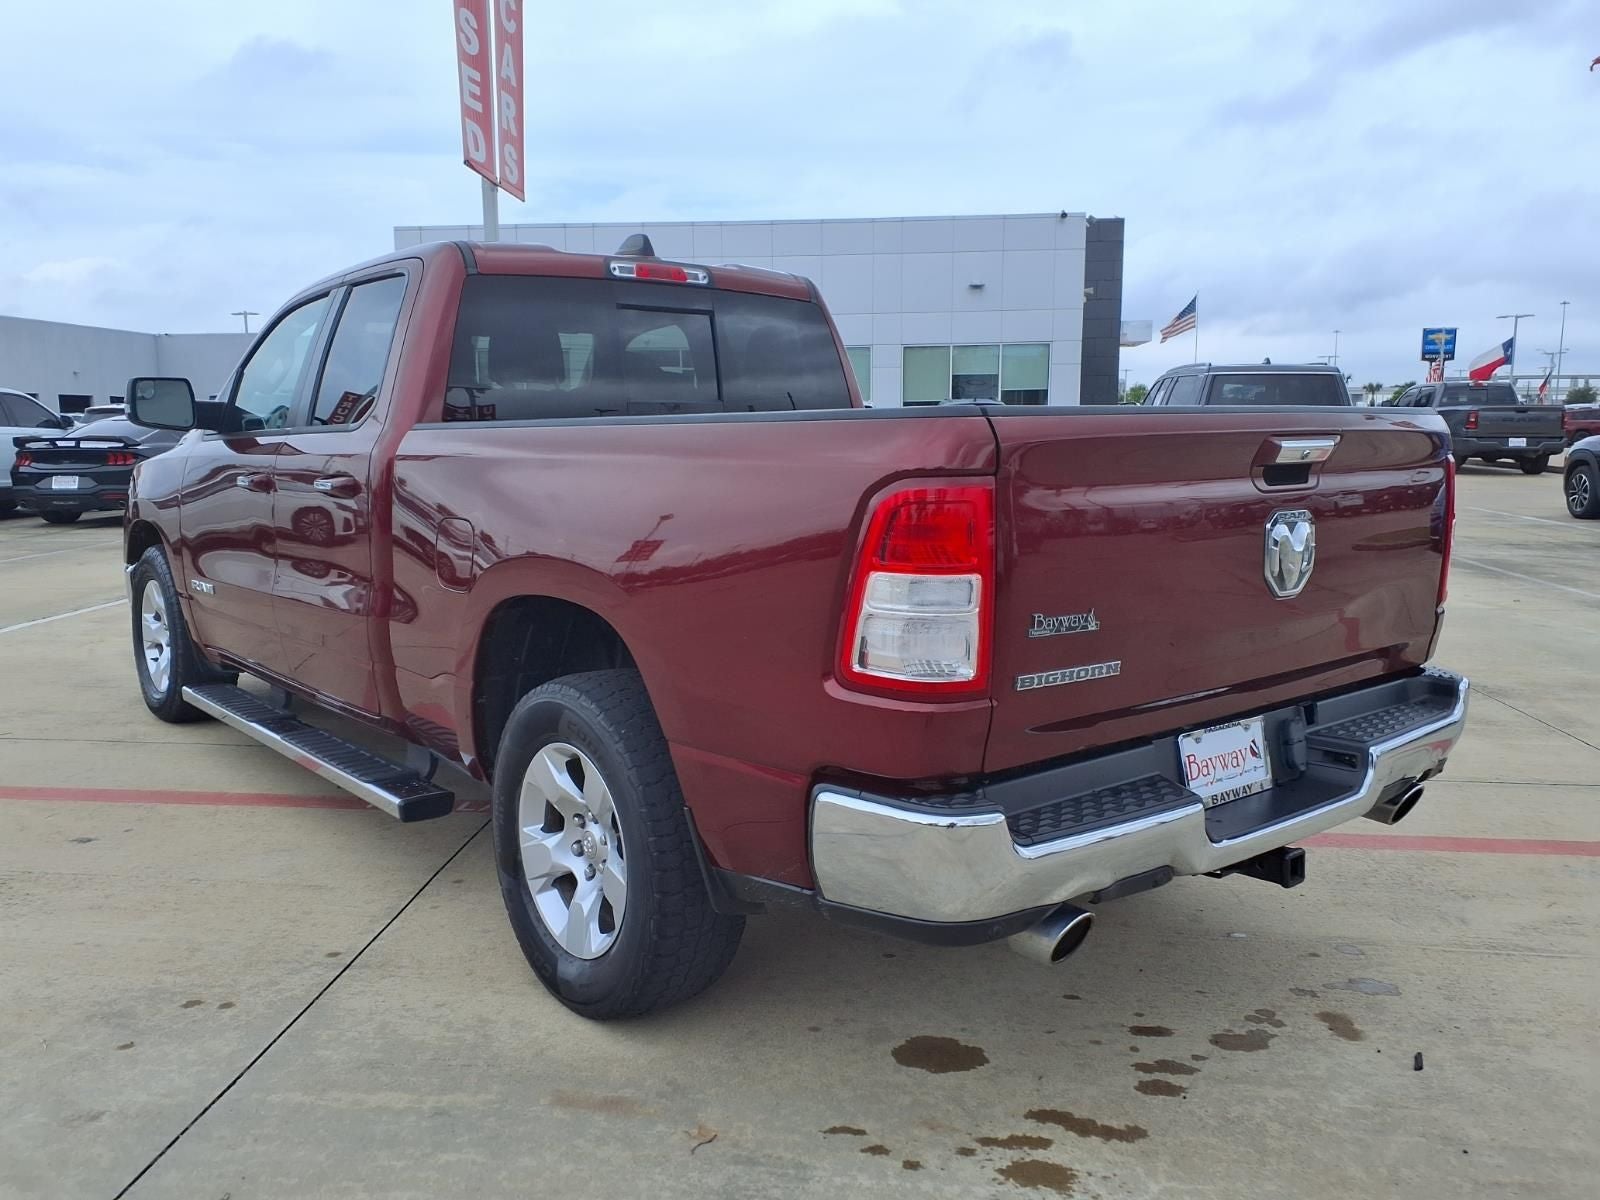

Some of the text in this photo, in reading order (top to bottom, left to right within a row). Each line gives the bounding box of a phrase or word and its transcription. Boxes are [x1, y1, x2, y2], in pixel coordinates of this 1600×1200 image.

[459, 7, 486, 163] SED
[500, 0, 519, 185] CARS
[1031, 612, 1087, 633] Bayway
[1017, 660, 1121, 691] BIGHORN
[1185, 747, 1248, 785] Bayway
[1211, 784, 1254, 805] BAYWAY
